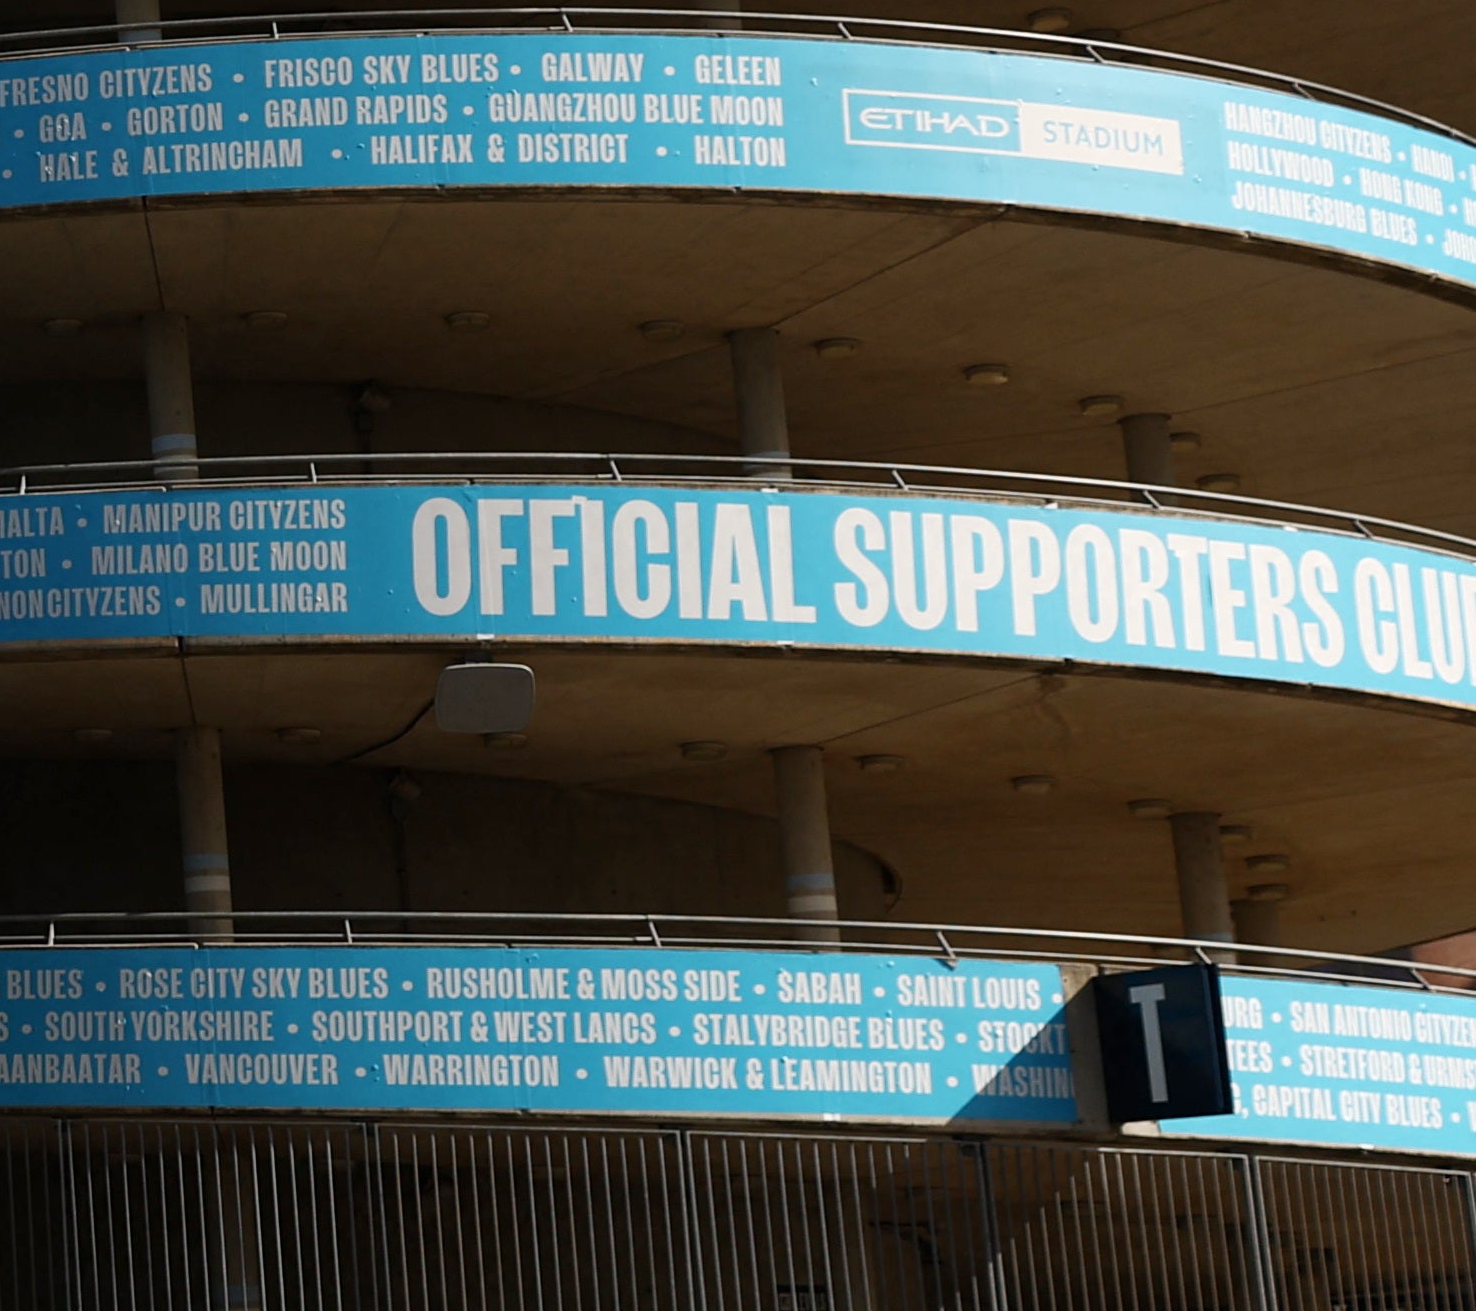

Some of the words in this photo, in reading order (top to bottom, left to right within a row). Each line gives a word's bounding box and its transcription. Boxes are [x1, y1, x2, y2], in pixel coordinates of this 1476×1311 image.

[0, 72, 89, 107] FRESNO
[265, 56, 353, 88] FRISCO
[364, 55, 410, 84] SKY
[422, 53, 499, 83] BLUES
[542, 53, 644, 82] GALWAY
[40, 112, 86, 142] GOA
[128, 102, 223, 136] GORTON
[265, 97, 348, 128] GRAND
[356, 94, 447, 124] RAPIDS
[490, 91, 636, 122] GUANGZHOU
[644, 94, 704, 124] BLUE
[711, 95, 783, 126] MOON
[859, 107, 1010, 138] ETIHAD
[1042, 121, 1163, 157] STADIUM
[37, 150, 98, 182] HALE
[143, 138, 302, 174] ALTRINCHAM
[371, 134, 473, 164] HALIFAX
[695, 135, 786, 167] HALTON
[104, 501, 221, 533] MANIPUR
[230, 499, 346, 530] CITYZENS
[92, 543, 188, 575] MILANO
[199, 542, 260, 572] BLUE
[271, 541, 346, 571] MOON
[202, 582, 348, 613] MULLINGAR
[413, 495, 817, 624] OFFICIAL
[833, 506, 1345, 668] SUPPORTERS
[7, 969, 82, 999] BLUES
[120, 968, 183, 998] ROSE
[252, 968, 301, 998] SKY
[309, 968, 388, 999] BLUES
[428, 968, 570, 999] RUSHOLME
[601, 969, 678, 1000] MOSS
[778, 970, 861, 1004] SABAH
[46, 1011, 126, 1041] SOUTH
[131, 1010, 274, 1041] YORKSHIRE
[313, 1011, 463, 1042] SOUTHPORT
[493, 1011, 567, 1042] WEST
[574, 1012, 656, 1044] LANCS
[694, 1013, 863, 1048] STALYBRIDGE
[868, 1017, 945, 1051] BLUES
[1130, 984, 1168, 1103] T
[186, 1054, 338, 1085] VANCOUVER
[384, 1055, 559, 1086] WARRINGTON
[604, 1056, 738, 1089] WARWICK
[771, 1056, 932, 1094] LEAMINGTON
